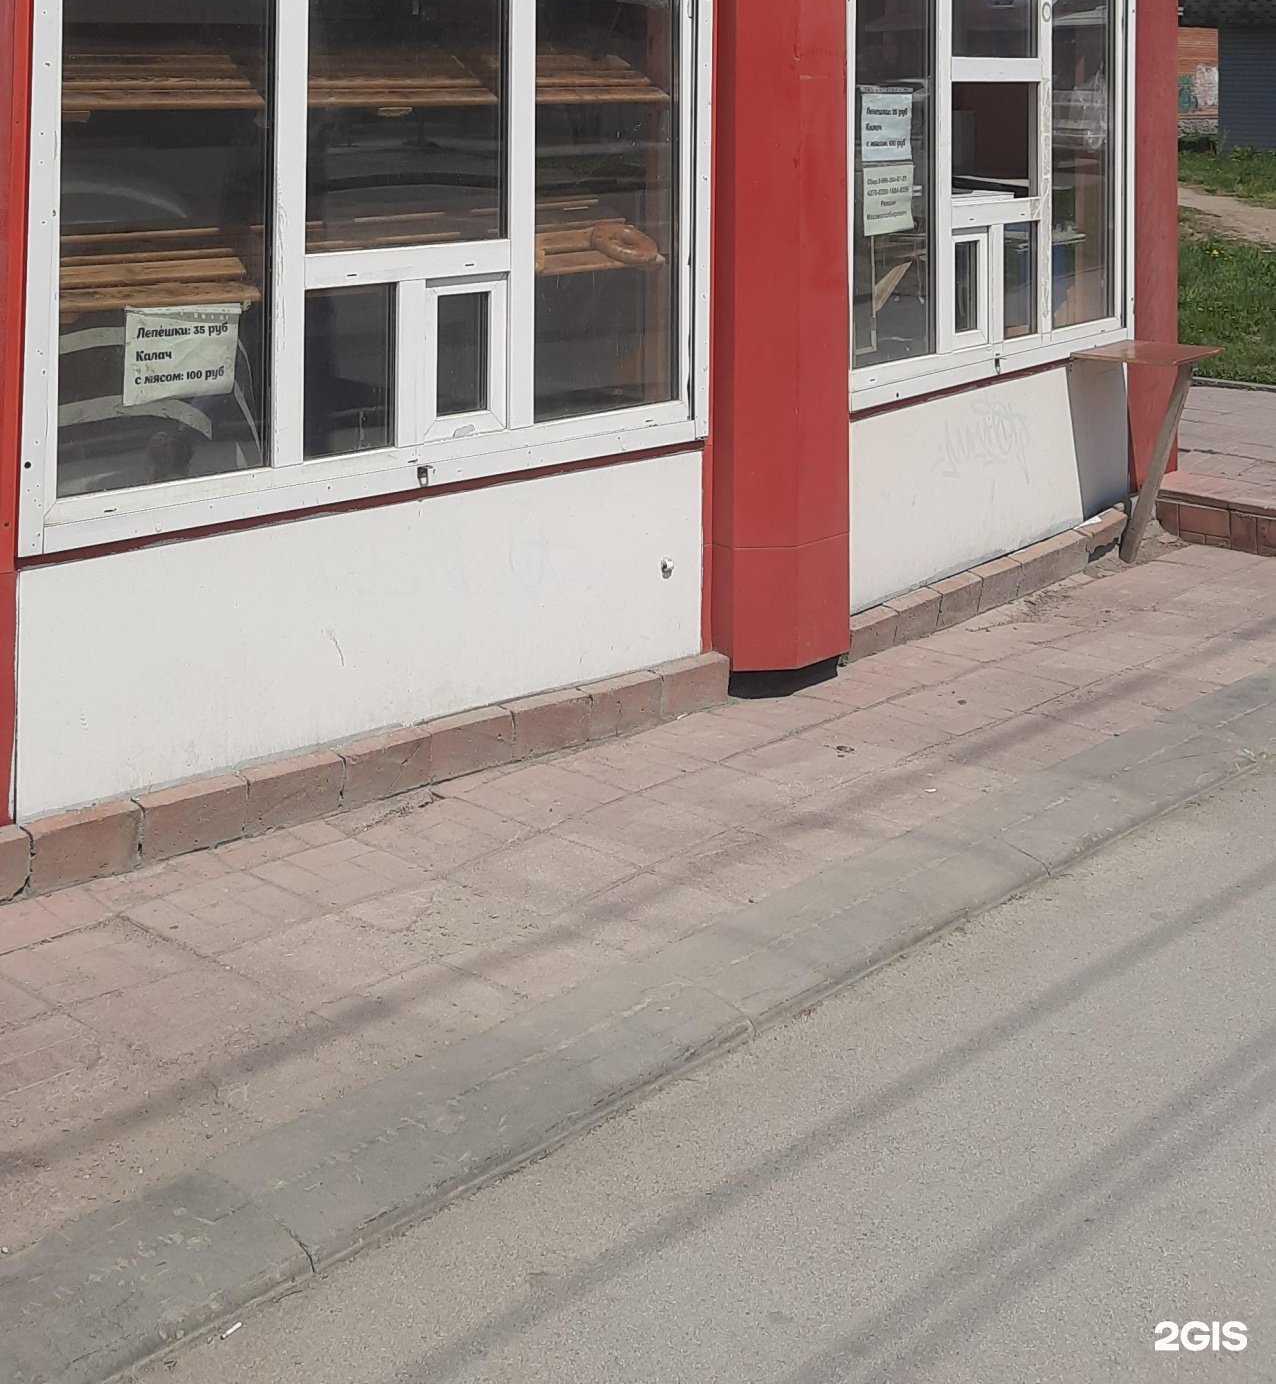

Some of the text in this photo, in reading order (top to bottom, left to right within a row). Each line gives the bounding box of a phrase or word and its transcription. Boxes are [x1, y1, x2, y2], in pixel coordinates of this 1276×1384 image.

[193, 325, 206, 335] 35
[208, 322, 228, 336] руб
[135, 350, 172, 362] Калач
[134, 365, 225, 385] с мясом: 100 руб
